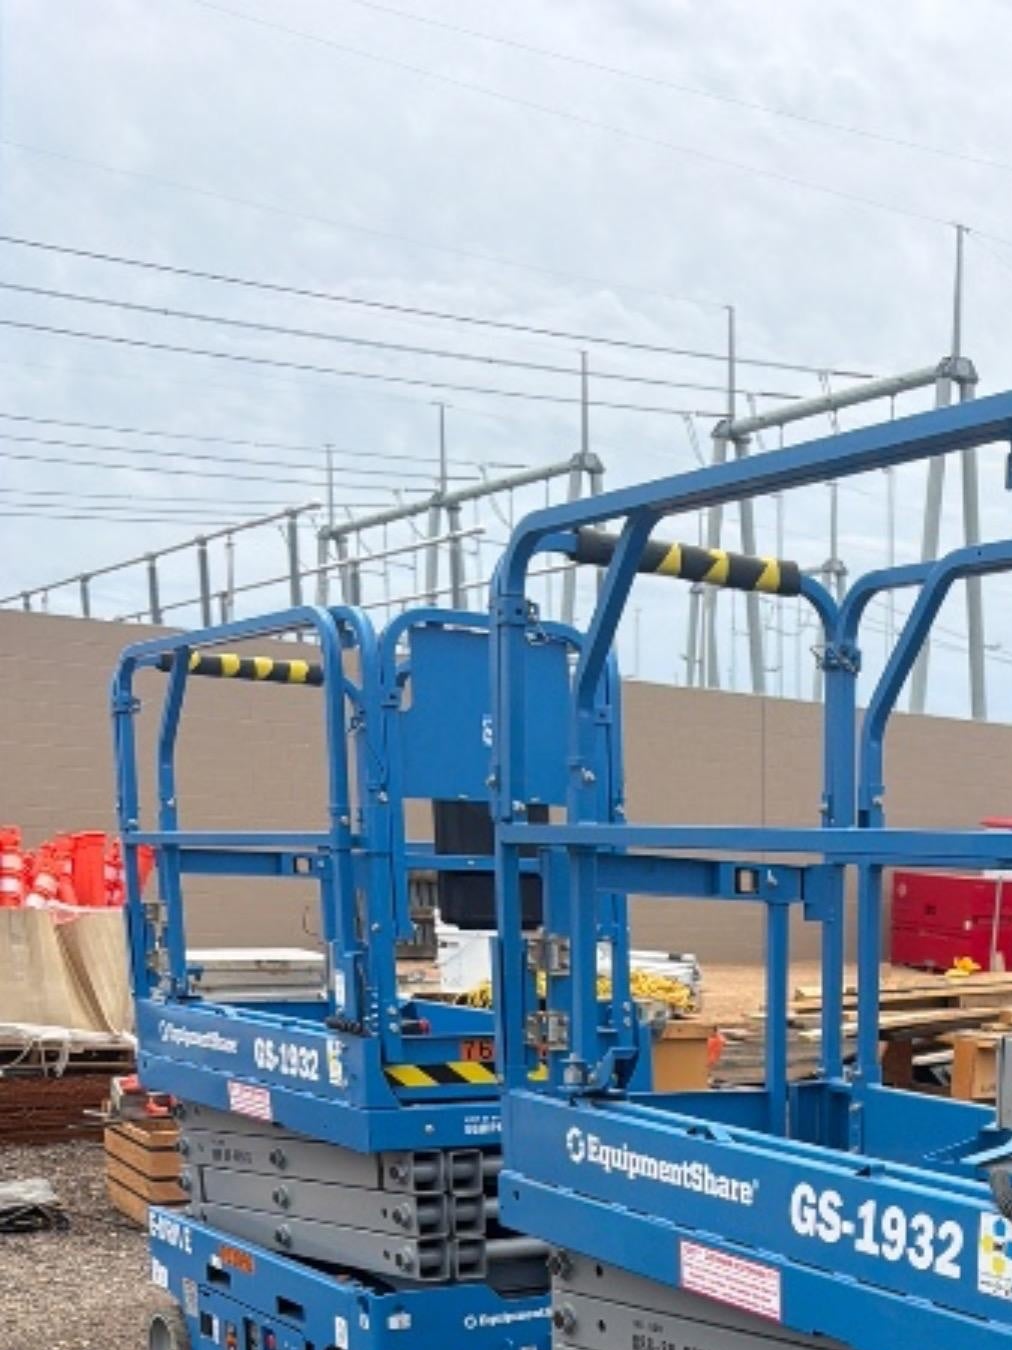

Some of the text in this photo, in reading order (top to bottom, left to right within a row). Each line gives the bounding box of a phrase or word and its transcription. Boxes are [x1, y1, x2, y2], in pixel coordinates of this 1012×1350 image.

[253, 1037, 320, 1081] GS-1932
[587, 1133, 755, 1206] EquipmentShare
[790, 1183, 965, 1280] GS-1932
